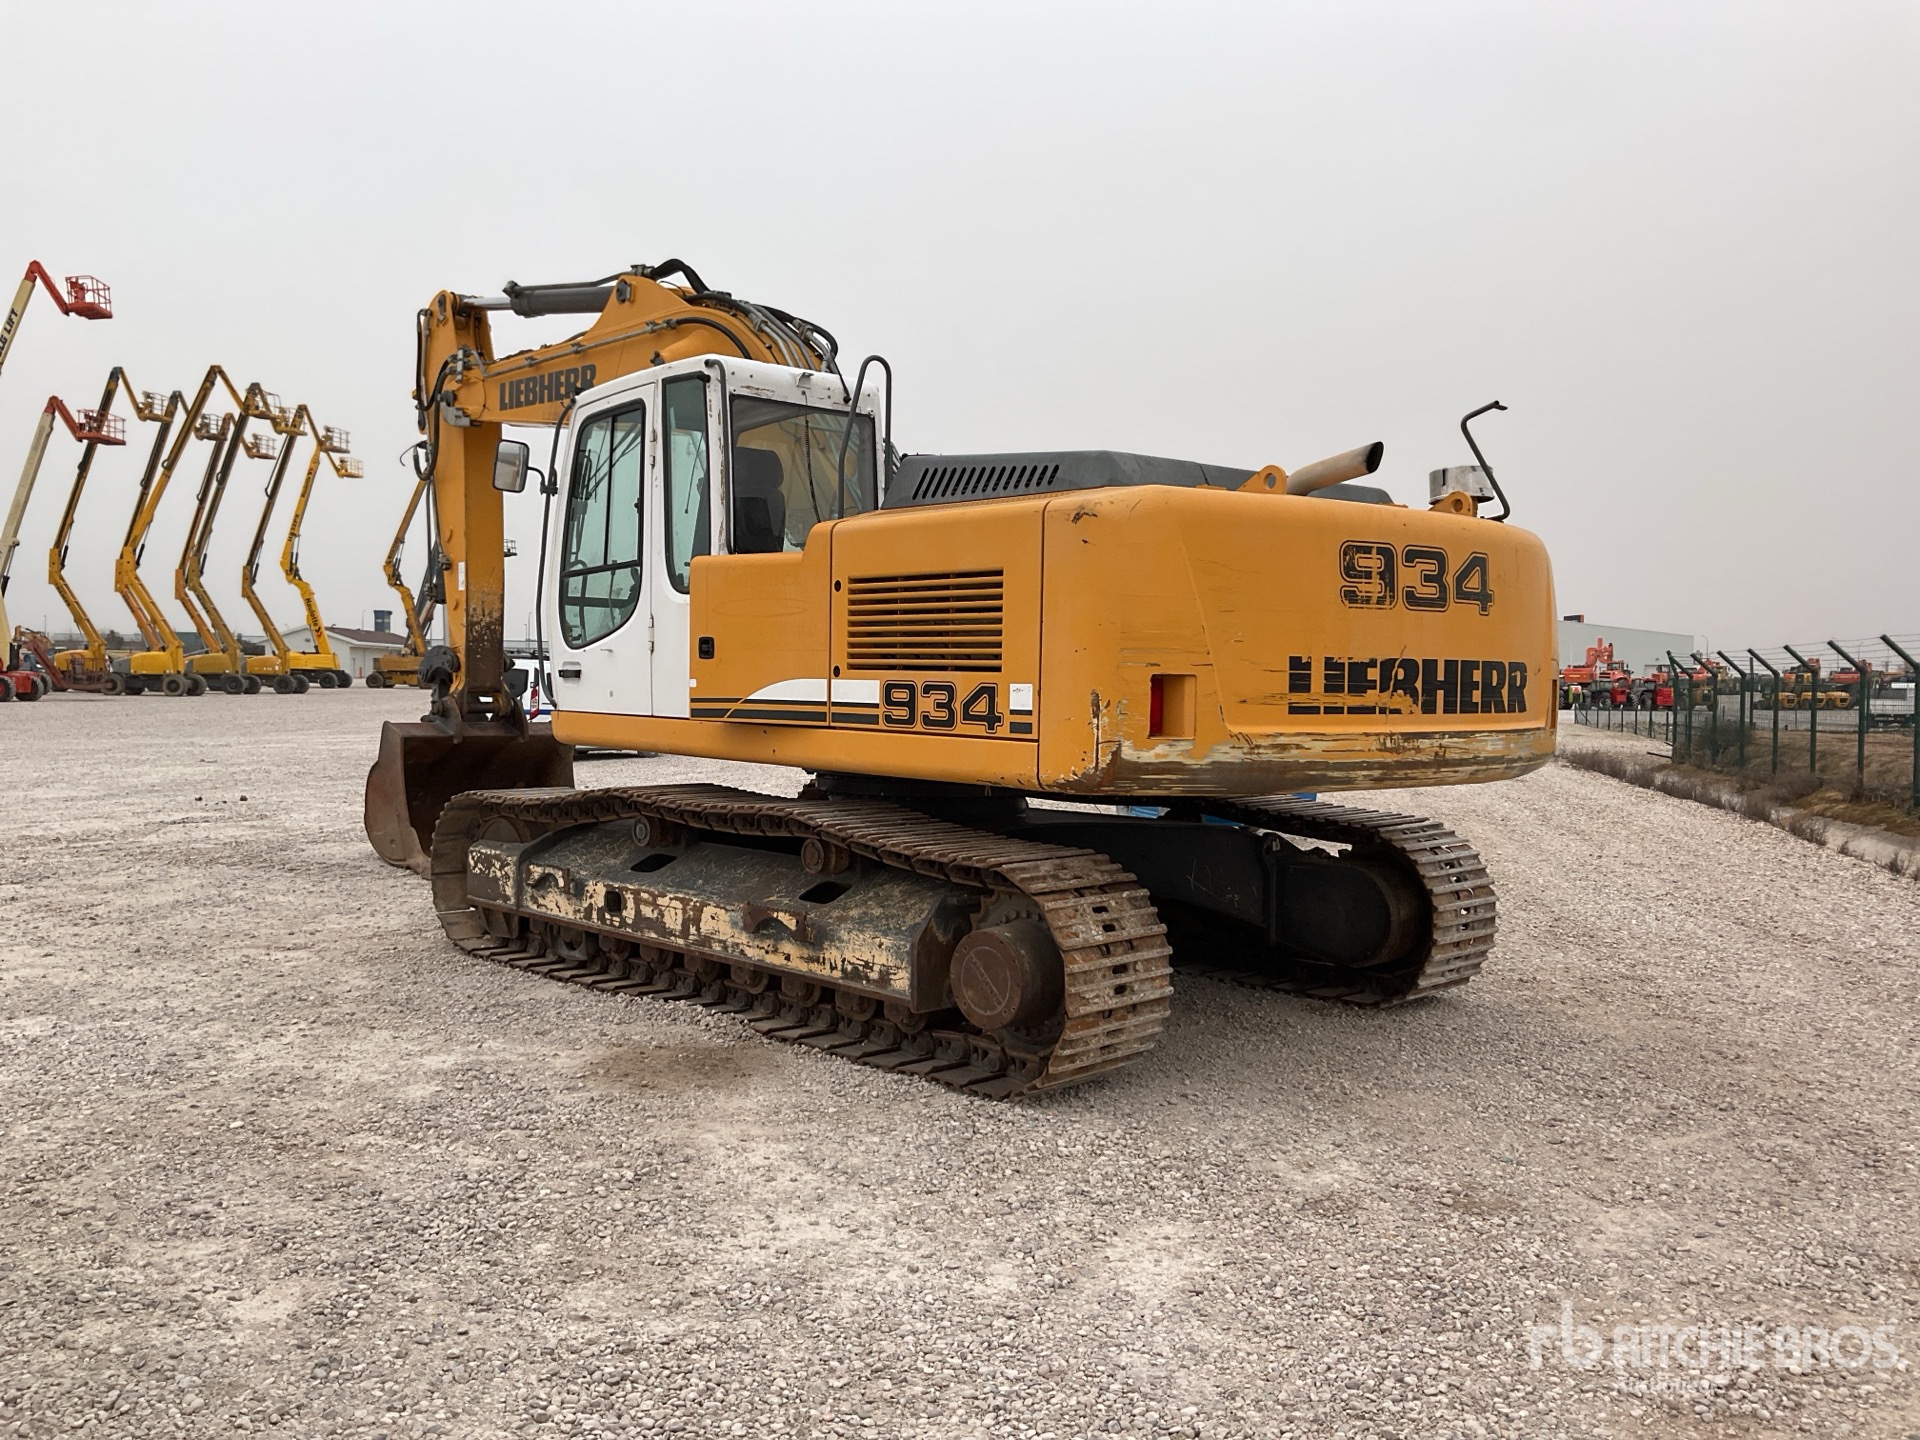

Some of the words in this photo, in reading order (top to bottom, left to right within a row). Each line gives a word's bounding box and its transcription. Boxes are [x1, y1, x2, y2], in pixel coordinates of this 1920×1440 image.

[3, 307, 19, 335] LIFT
[499, 363, 597, 412] LIEBHERR
[1338, 539, 1495, 617] 934
[882, 679, 1005, 734] 934
[1288, 655, 1528, 716] LIEBHERR
